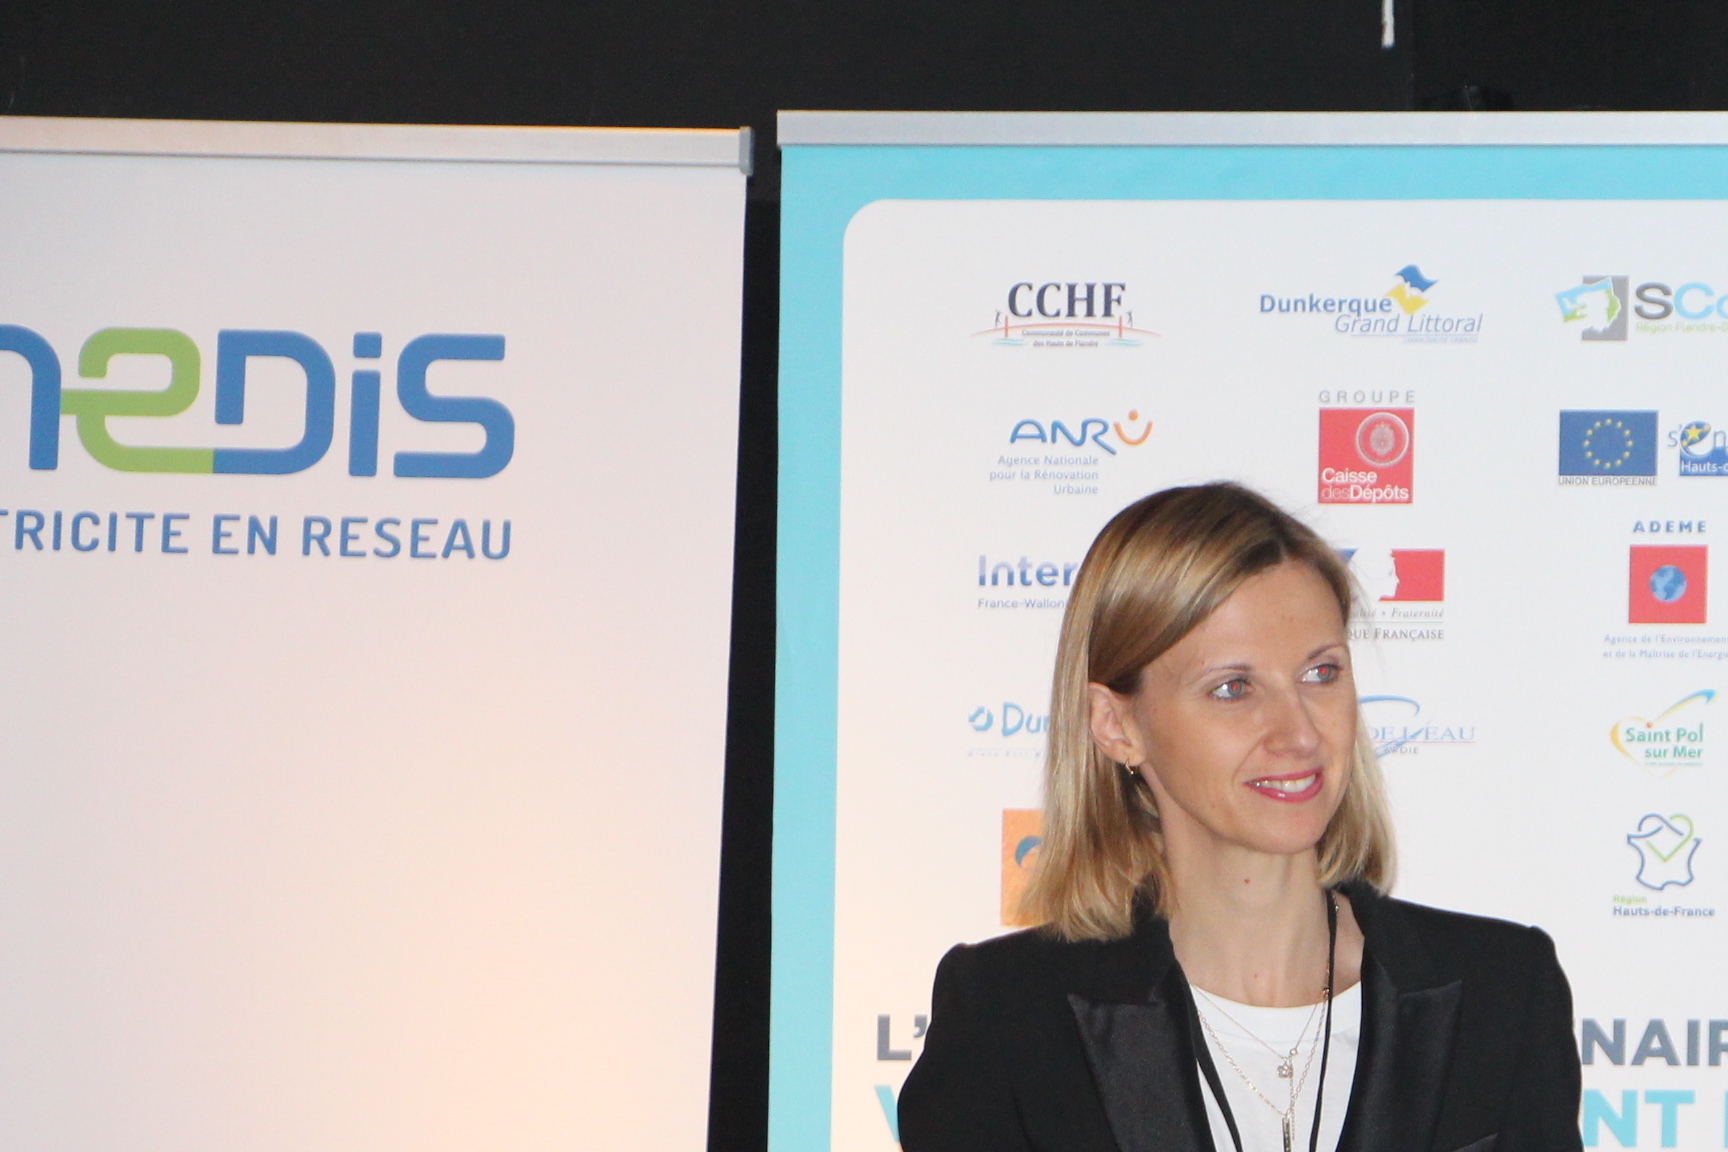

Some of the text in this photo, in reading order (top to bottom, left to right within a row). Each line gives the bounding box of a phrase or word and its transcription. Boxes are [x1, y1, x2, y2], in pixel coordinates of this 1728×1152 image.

[1008, 281, 1126, 318] CCHF
[1259, 293, 1393, 317] Dunkerque
[1335, 313, 1484, 334] Grand Littoral
[1318, 389, 1416, 404] GROUPE
[998, 455, 1099, 467] Agence Nationale
[989, 469, 1099, 482] pour la Rénovation
[1321, 467, 1379, 484] Caisse
[1558, 476, 1590, 486] UNION
[1053, 483, 1099, 495] Urbaine
[1632, 519, 1708, 534] ADEME
[212, 512, 279, 556] EN
[301, 514, 512, 560] RESEAU
[1391, 606, 1445, 619] Fraternité
[1603, 633, 1638, 645] Agence
[1641, 634, 1652, 644] de
[1615, 649, 1626, 658] de
[1678, 650, 1690, 659] de
[1625, 721, 1704, 742] Saint Pol
[1378, 746, 1419, 755] ARDIE
[1644, 745, 1704, 758] sur Mer
[1612, 905, 1716, 918] Hauts-de-France
